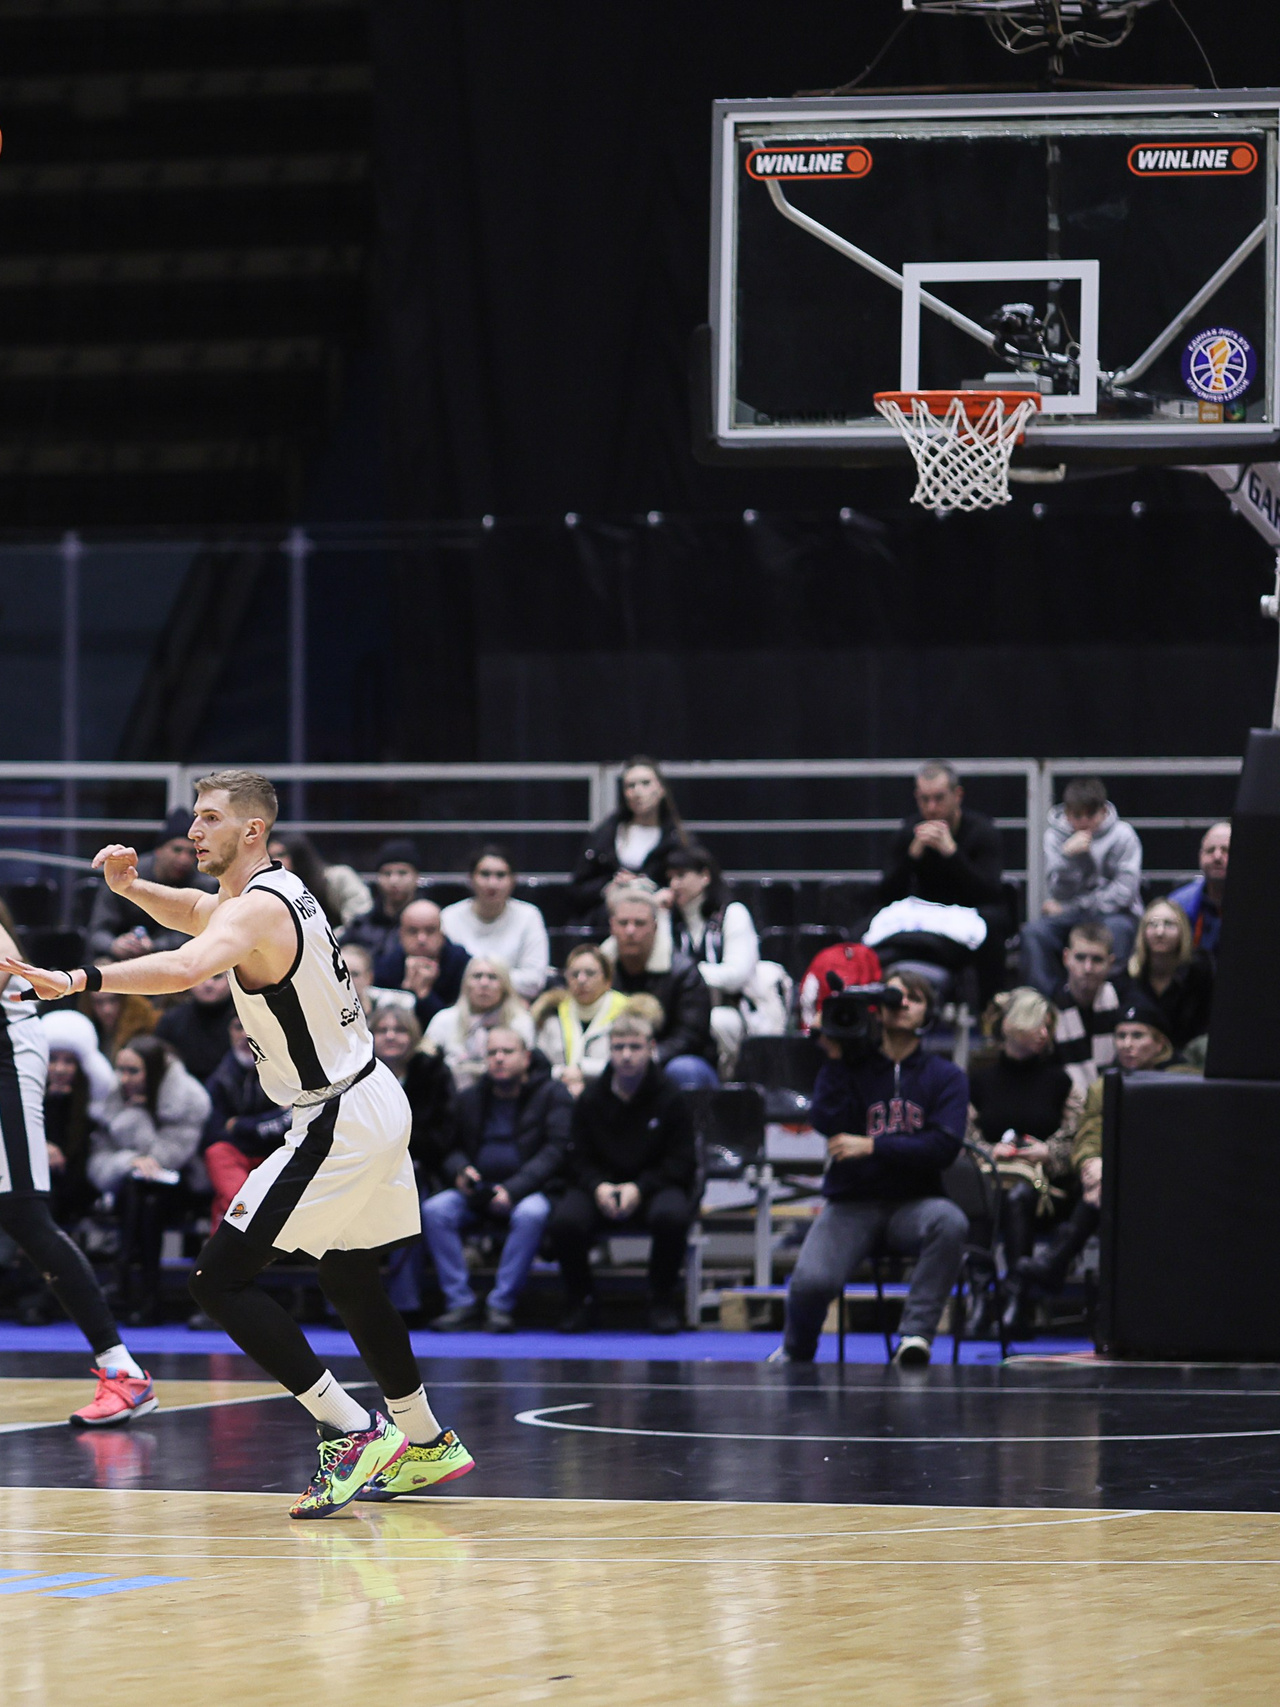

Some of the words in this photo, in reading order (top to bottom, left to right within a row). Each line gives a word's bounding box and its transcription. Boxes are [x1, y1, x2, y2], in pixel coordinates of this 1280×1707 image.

[755, 152, 845, 175] WINLINE
[1137, 148, 1229, 171] WINLINE
[866, 1097, 925, 1137] GAP
